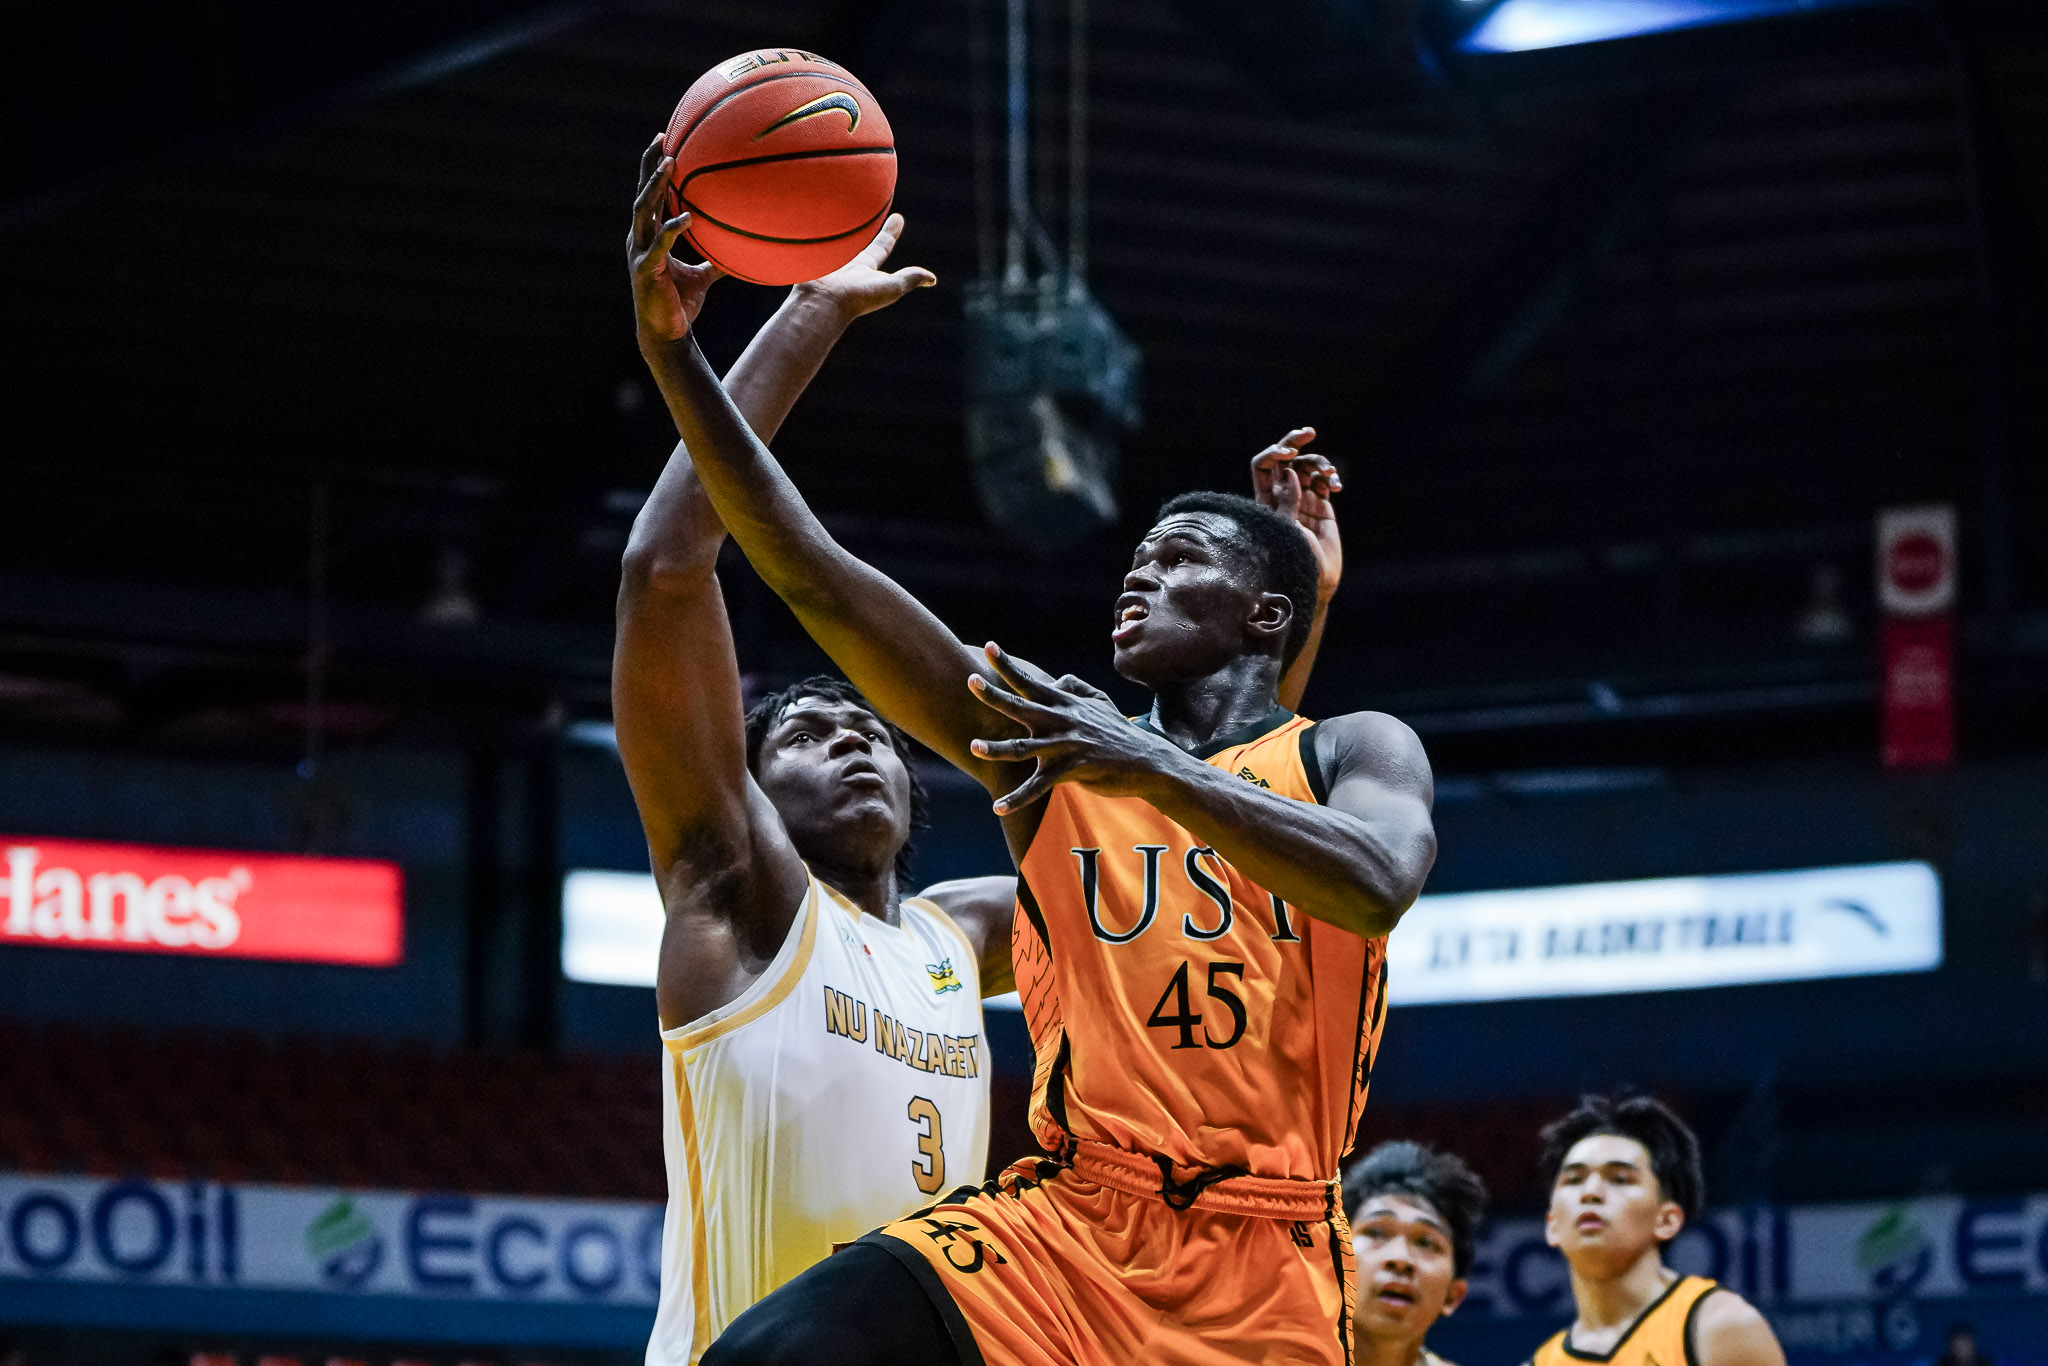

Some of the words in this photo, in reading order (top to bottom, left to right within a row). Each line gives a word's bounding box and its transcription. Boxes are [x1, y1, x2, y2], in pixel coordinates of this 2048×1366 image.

[823, 985, 868, 1044] NU
[873, 1008, 979, 1079] NAZARET
[1146, 960, 1248, 1050] 45
[907, 1095, 945, 1195] 3
[405, 1192, 664, 1293] Eco
[920, 1218, 1008, 1273] 45
